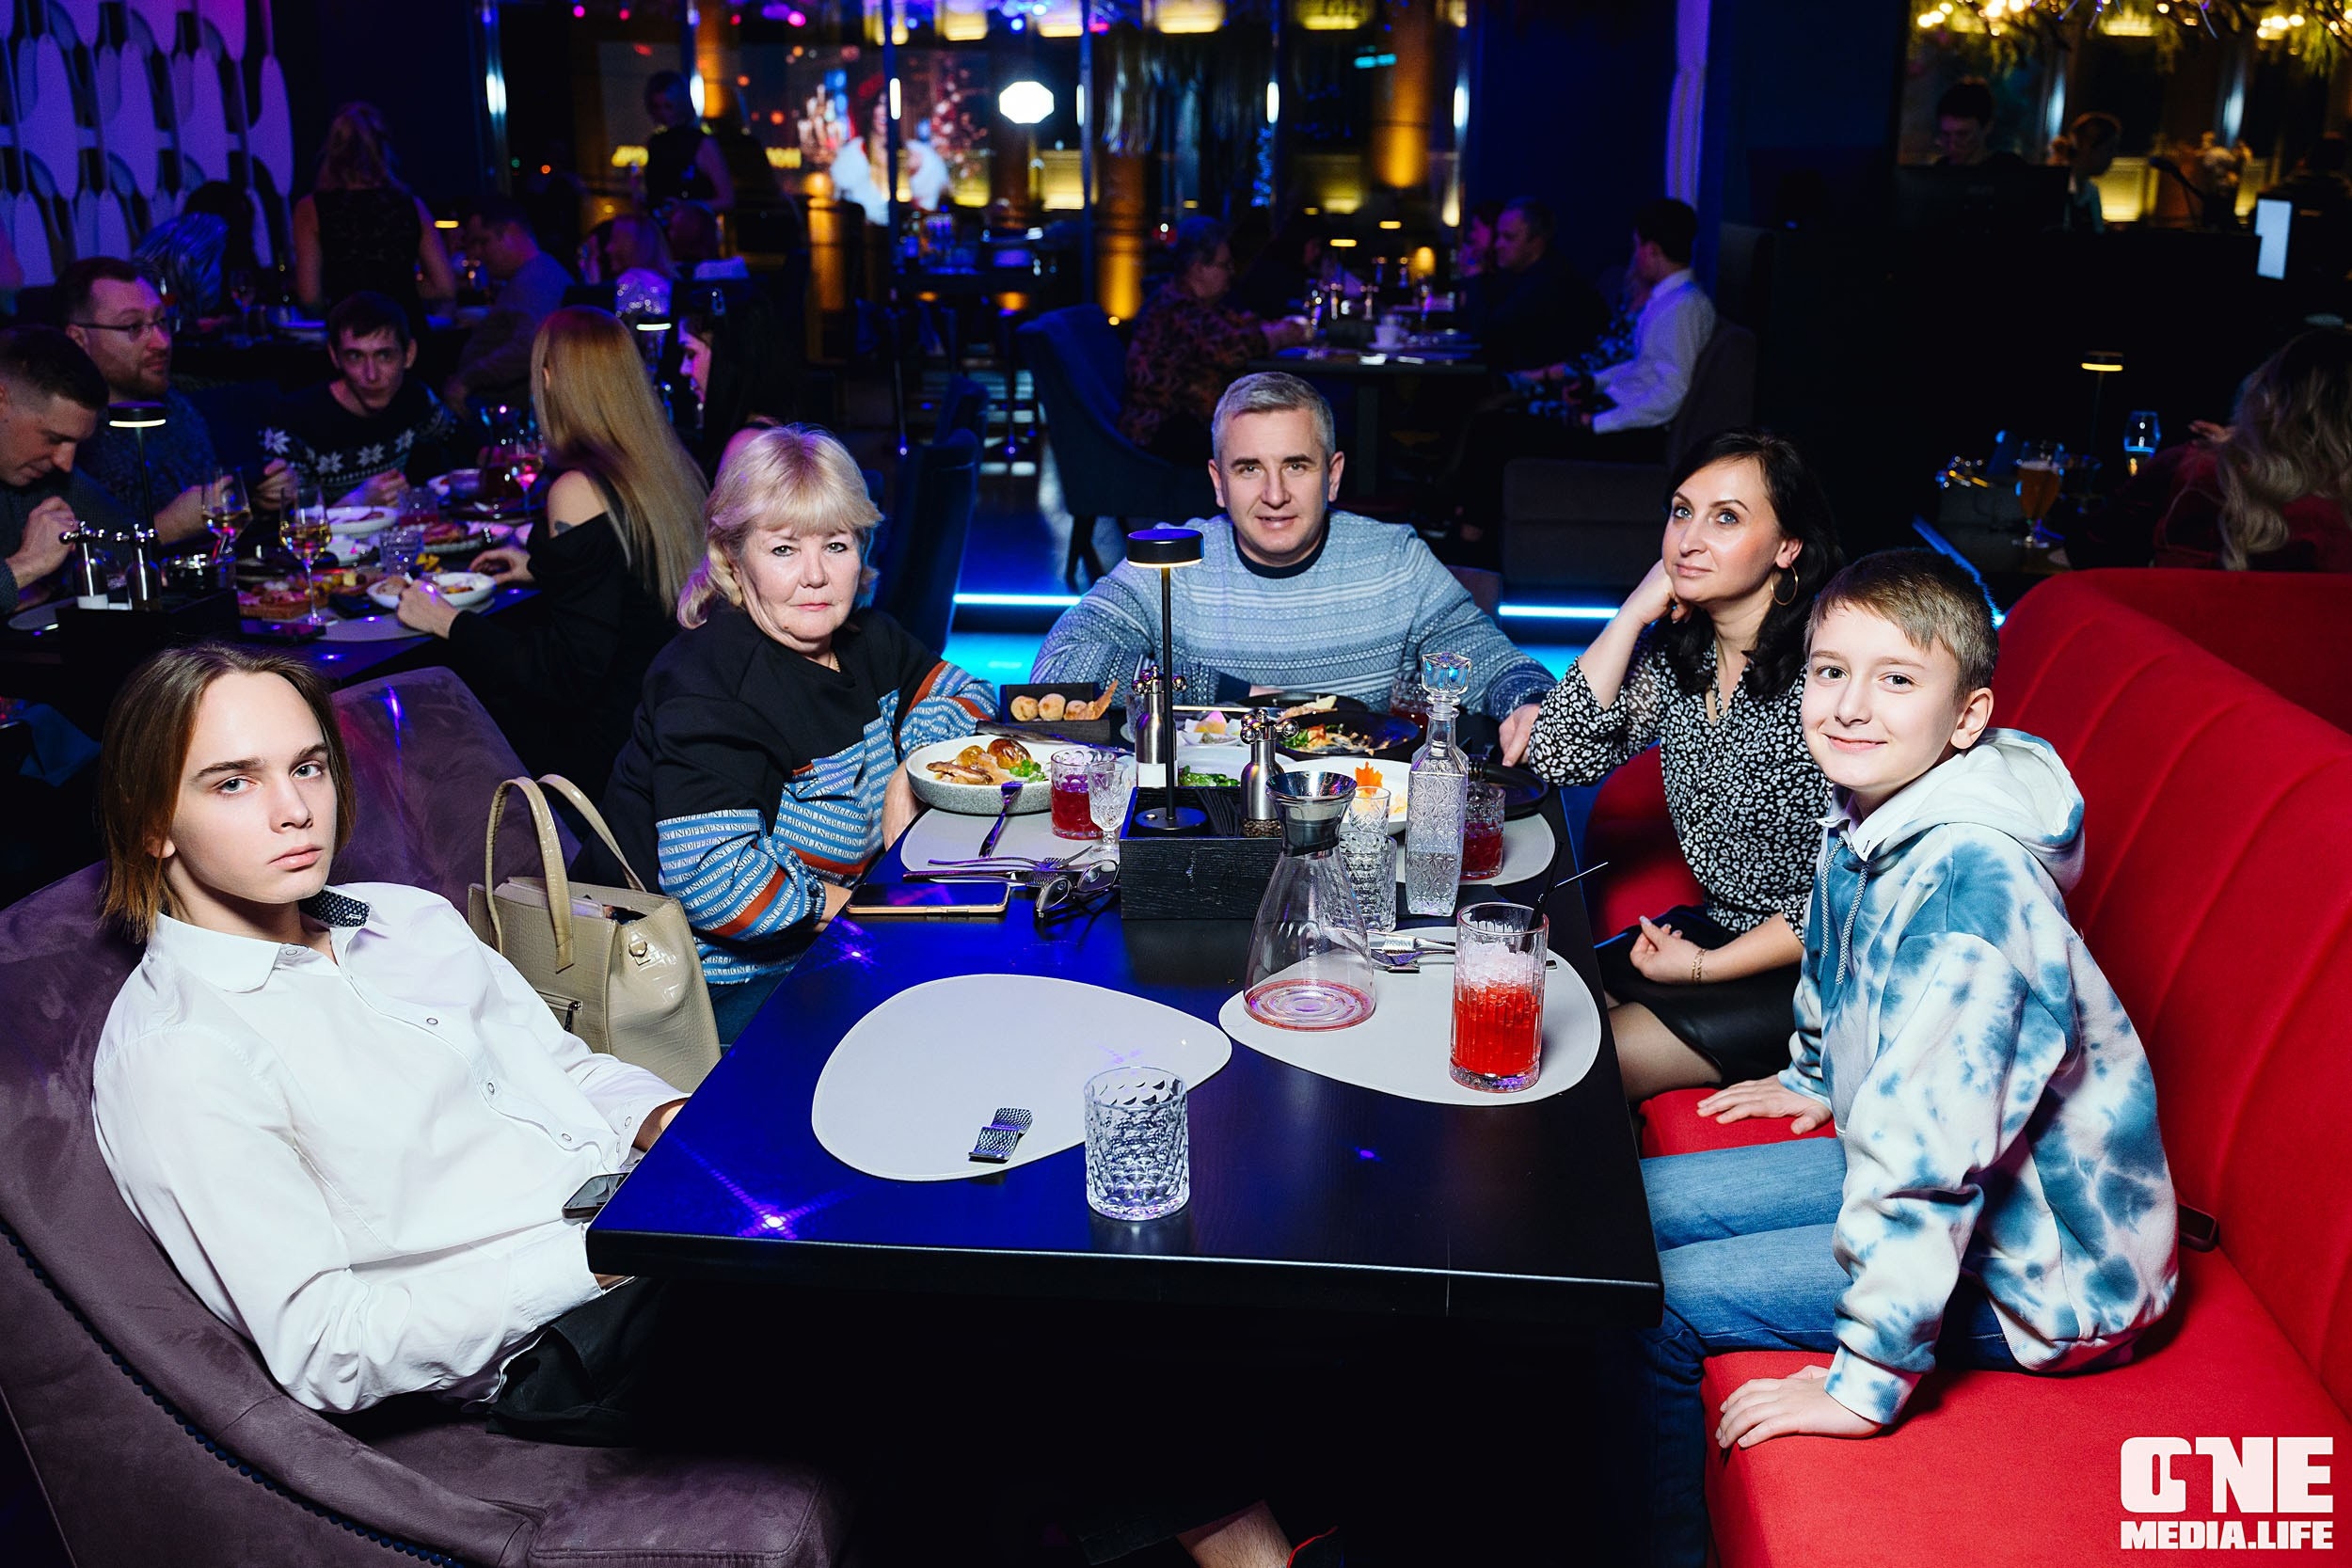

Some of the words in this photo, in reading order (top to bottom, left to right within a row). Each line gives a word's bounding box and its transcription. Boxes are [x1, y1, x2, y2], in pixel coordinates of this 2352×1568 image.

[674, 824, 728, 835] INDIFFRENT
[688, 859, 738, 893] INDIFFRENT
[706, 882, 744, 916] INDIFFRENT
[715, 893, 756, 927] INDIFFRENT
